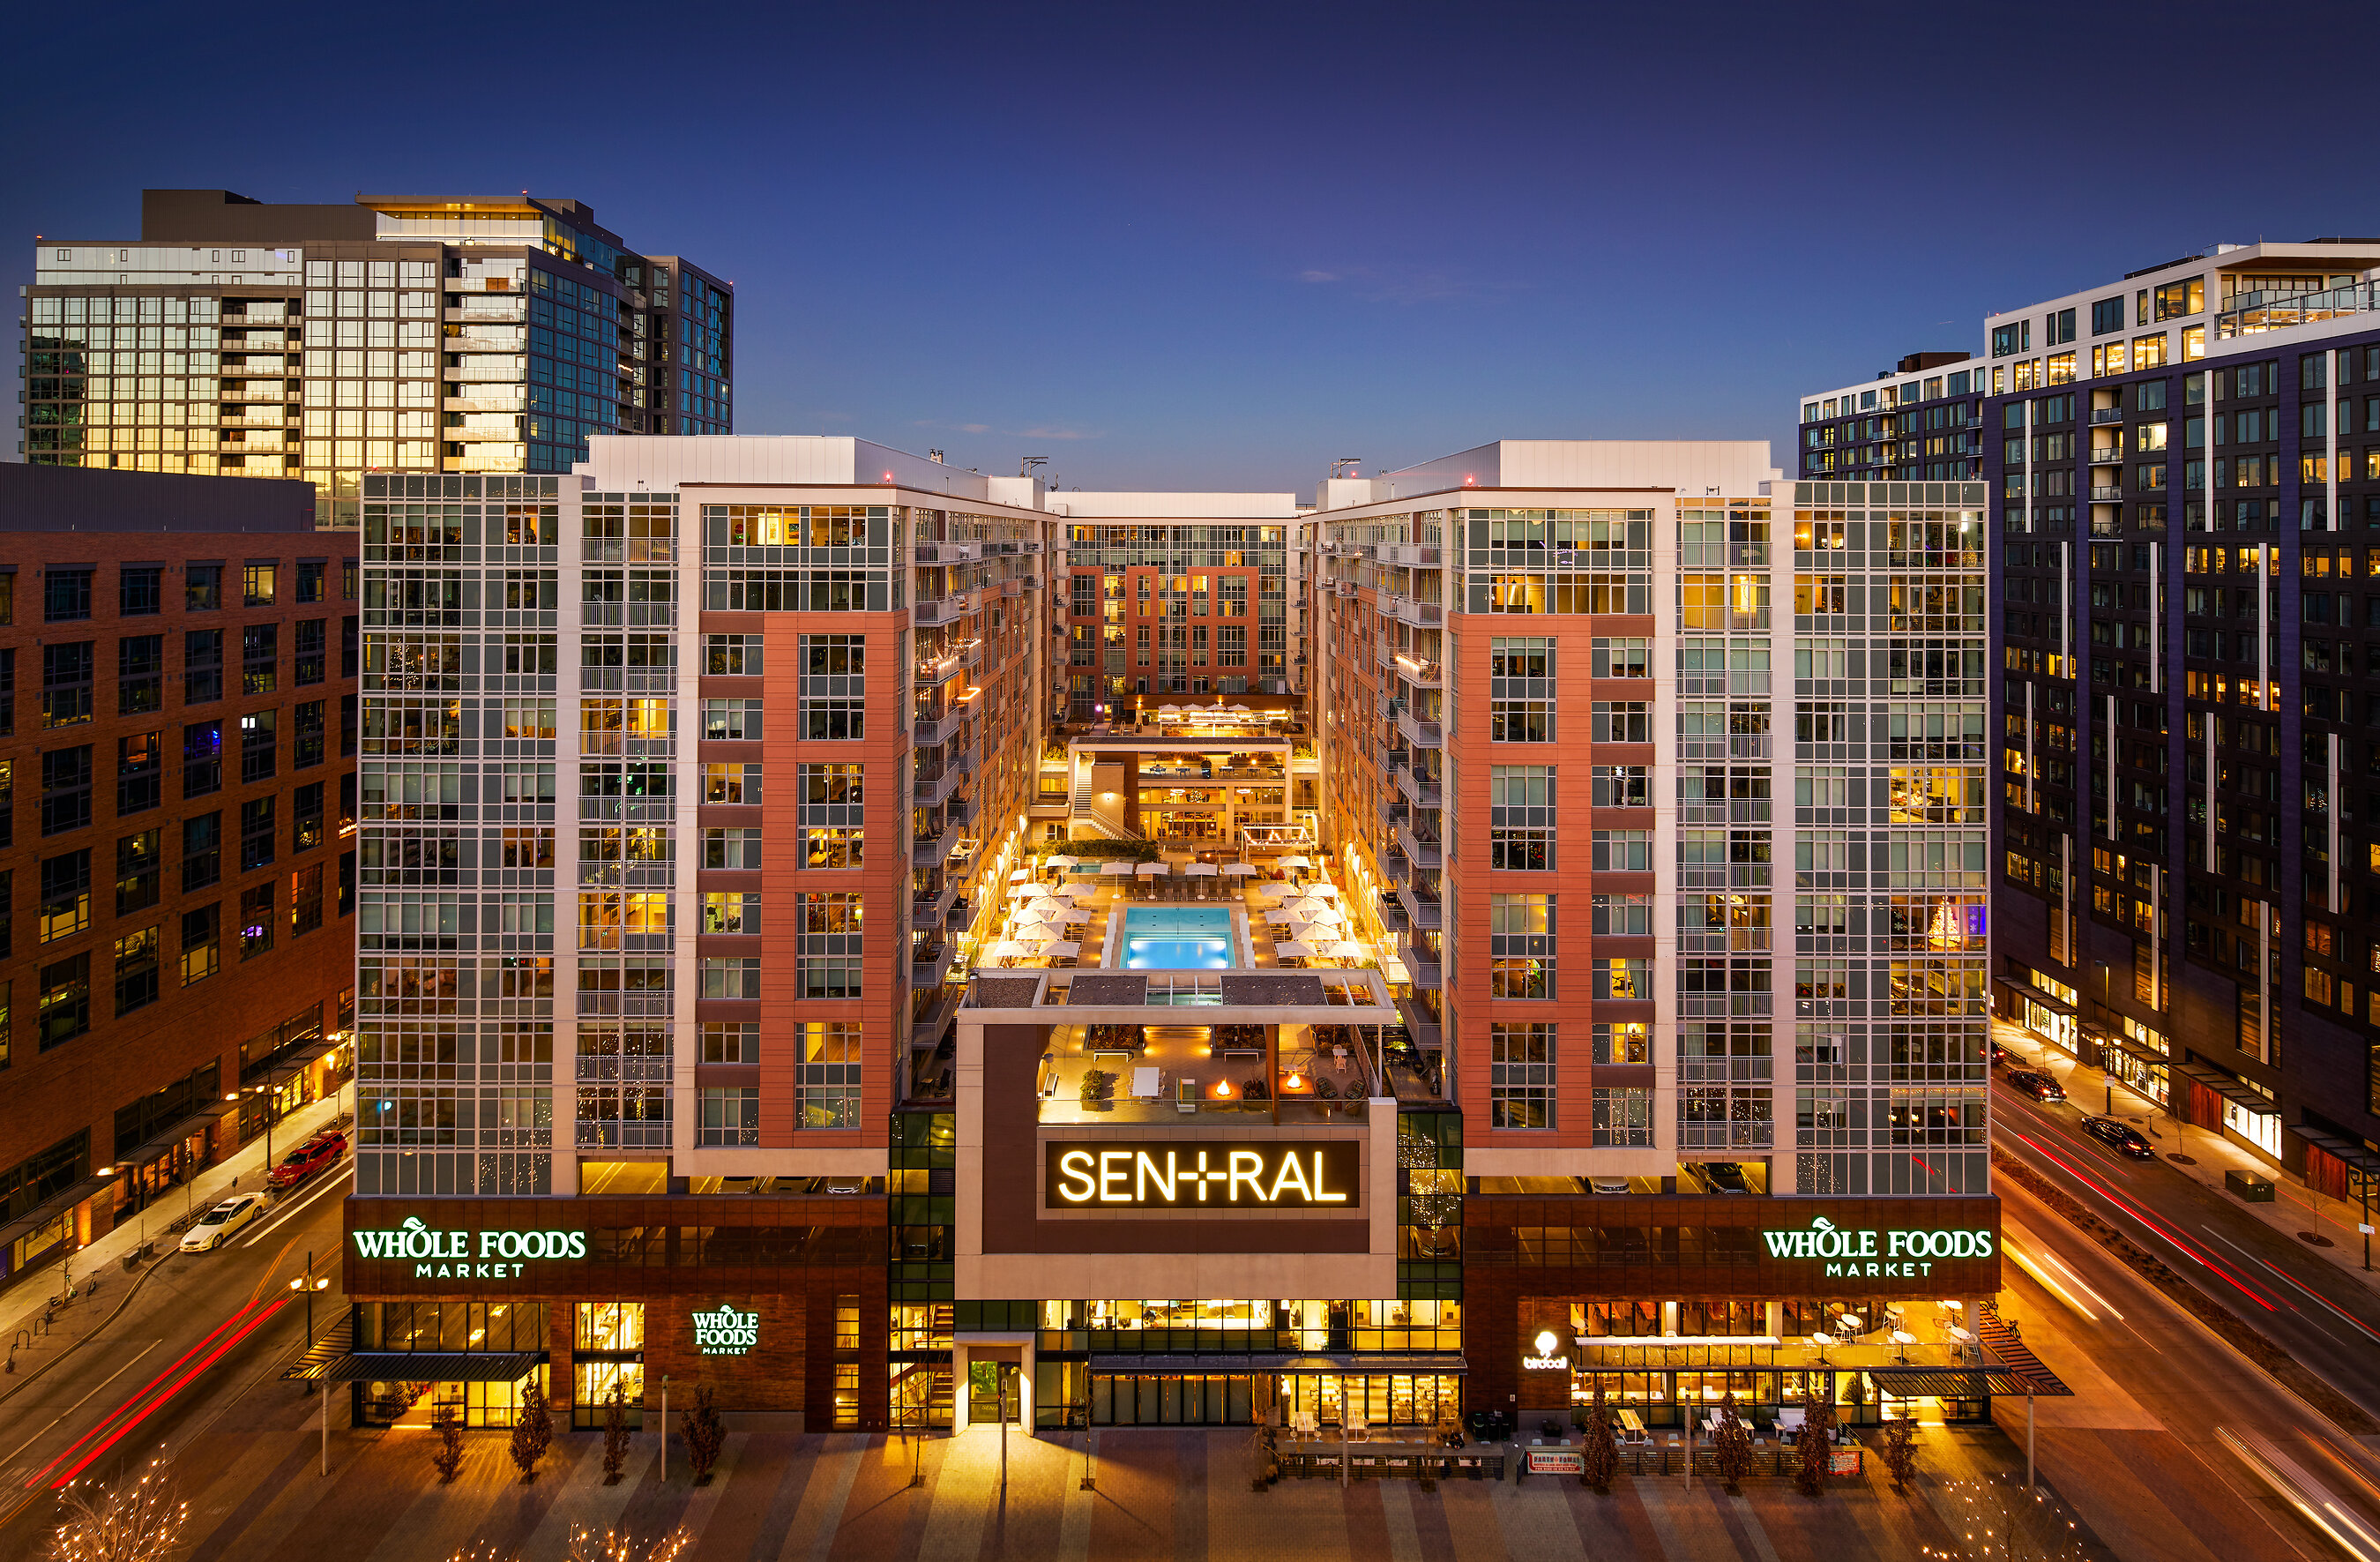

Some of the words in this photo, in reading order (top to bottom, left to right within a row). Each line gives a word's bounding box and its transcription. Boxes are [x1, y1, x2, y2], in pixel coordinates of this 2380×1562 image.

[353, 1229, 469, 1258] WHOLE
[479, 1230, 586, 1259] FOODS
[1763, 1229, 1878, 1258] WHOLE
[1887, 1230, 1993, 1258] FOODS
[415, 1263, 524, 1278] MARKET
[1826, 1262, 1932, 1277] MARKET
[691, 1312, 759, 1329] WHOLE
[695, 1328, 757, 1345] FOODS
[1523, 1355, 1568, 1370] birdcall
